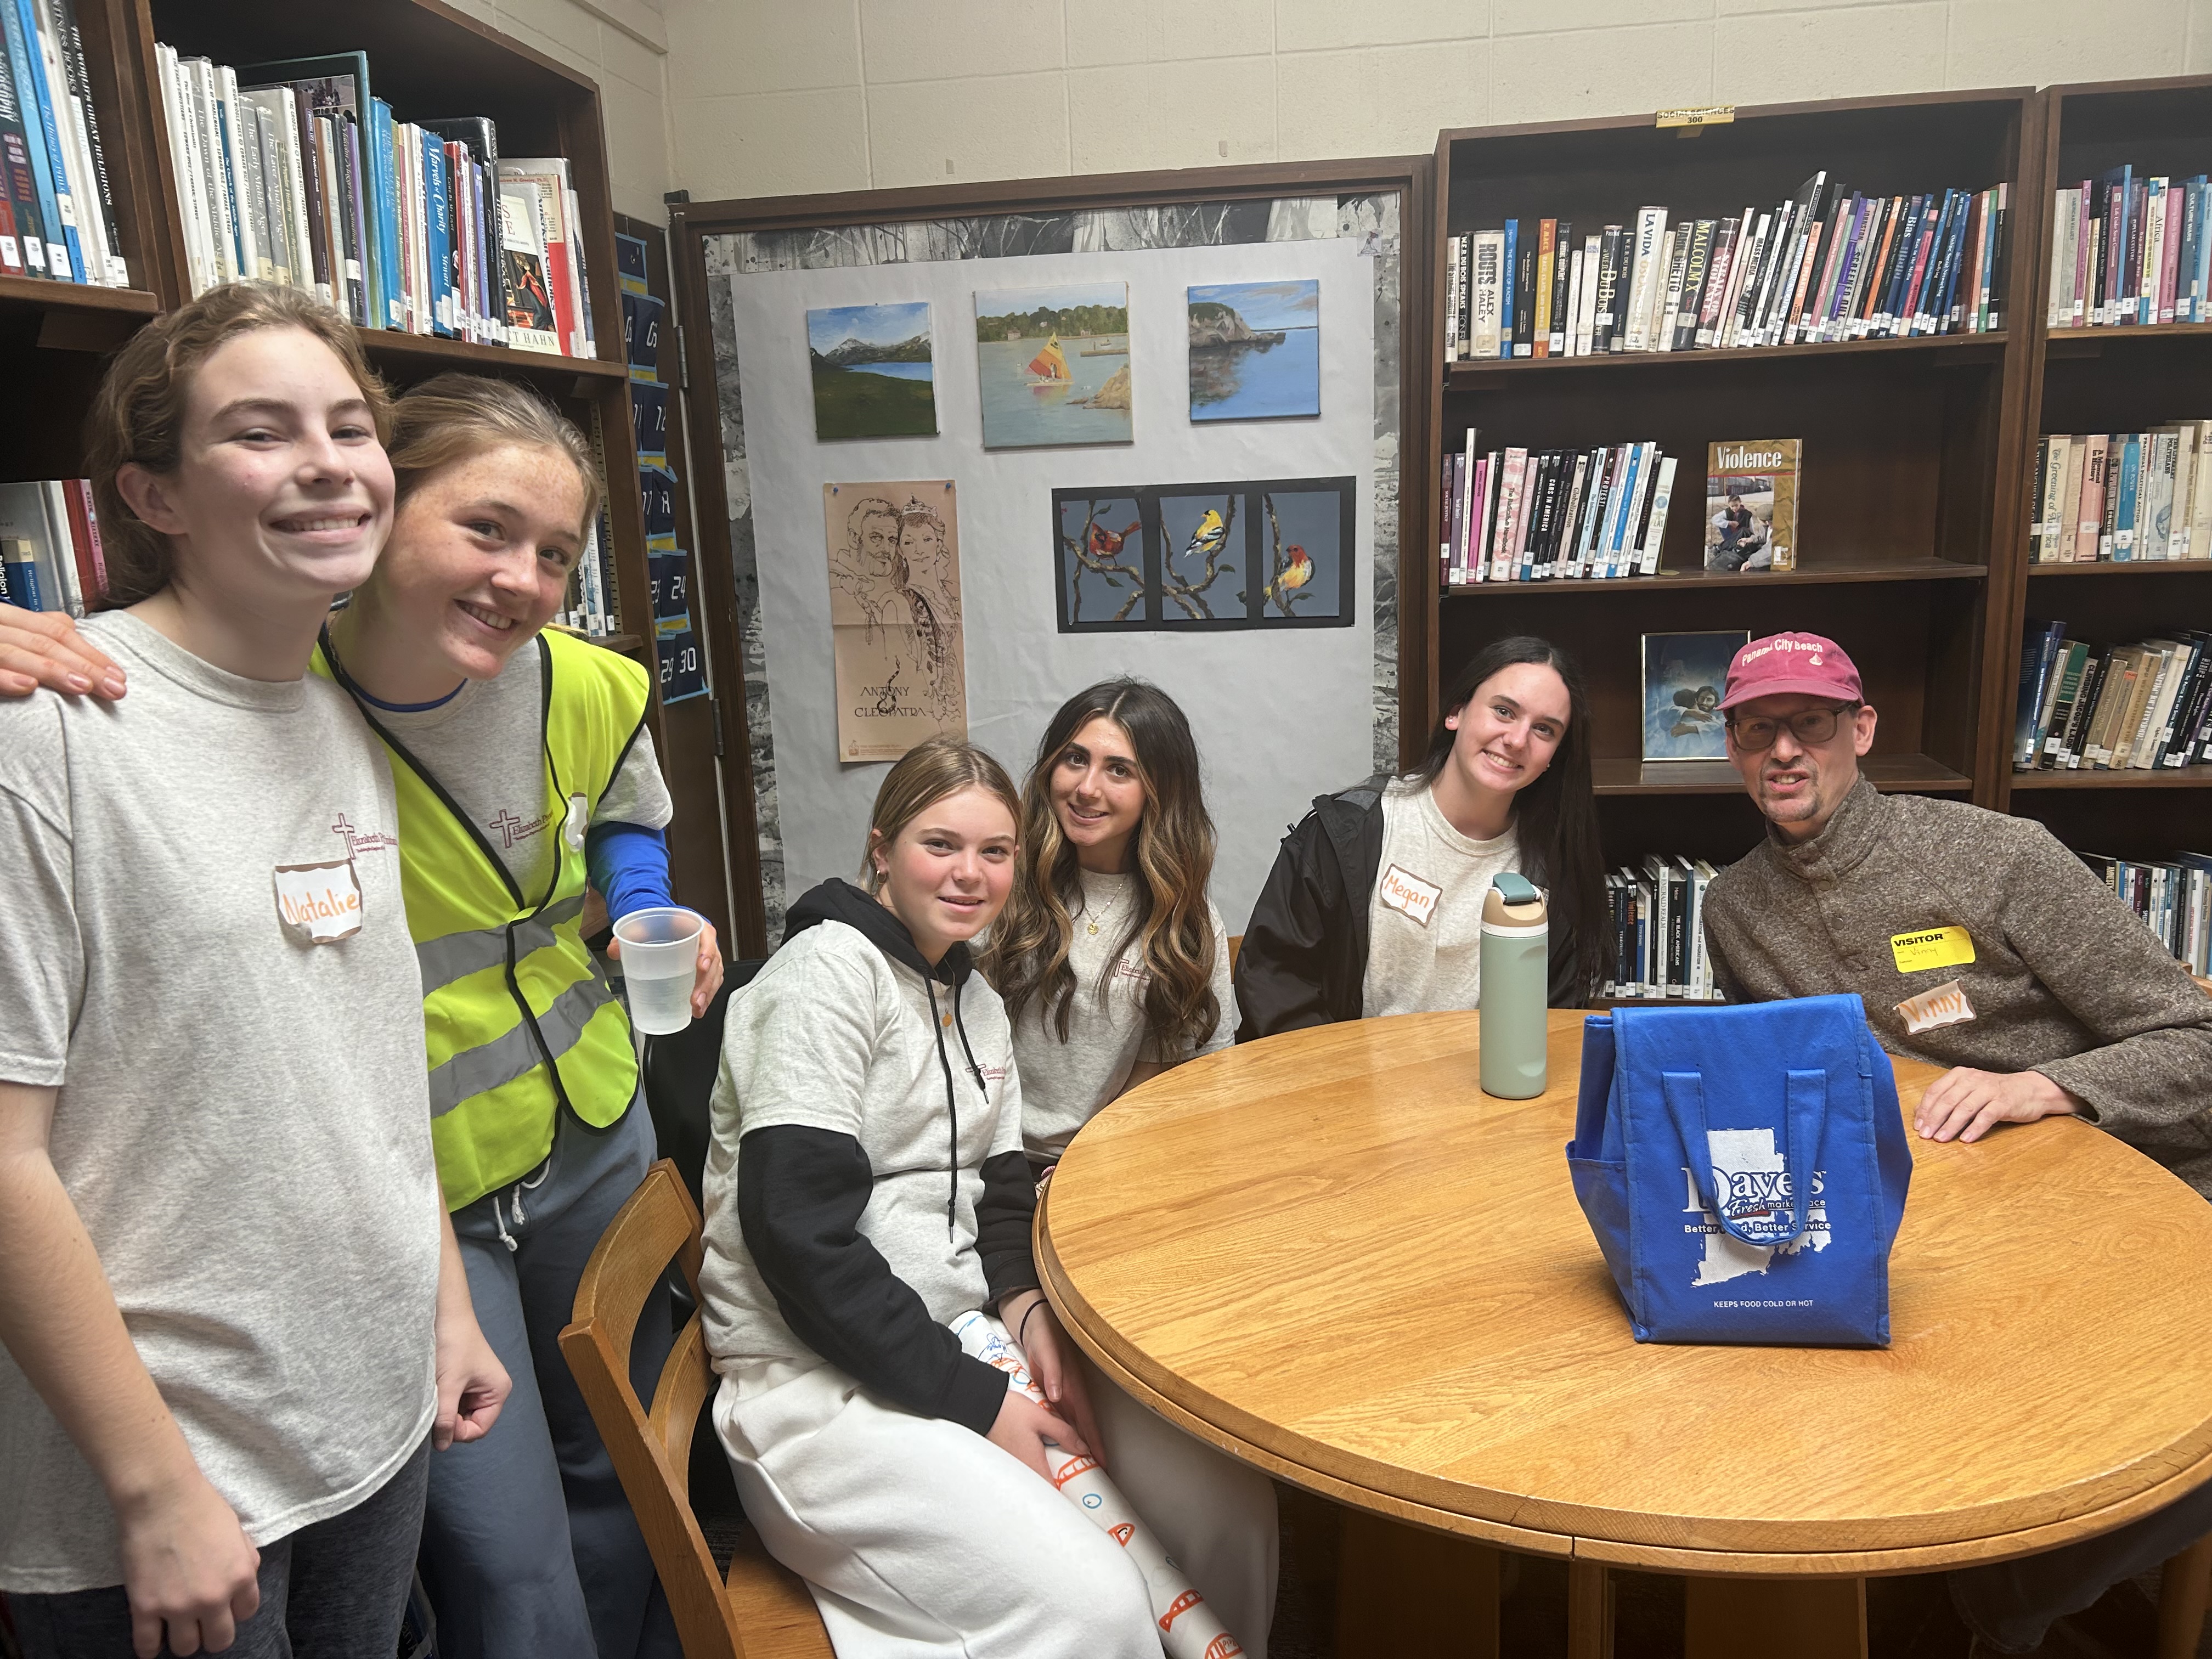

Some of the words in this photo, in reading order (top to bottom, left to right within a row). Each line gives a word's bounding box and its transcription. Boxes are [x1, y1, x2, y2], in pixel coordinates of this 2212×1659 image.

[69, 25, 82, 50] THE
[74, 52, 93, 103] WORLD'S
[84, 103, 100, 143] GREAT
[196, 108, 206, 128] The
[209, 99, 219, 137] CHARLEMAGNE
[246, 121, 256, 140] The
[199, 132, 211, 163] Dawn
[266, 131, 275, 150] The
[247, 145, 260, 170] Early
[268, 153, 279, 178] Later
[427, 142, 443, 186] Marvels
[93, 143, 114, 206] RELIGIONS
[205, 167, 213, 179] of
[206, 182, 216, 200] the
[253, 173, 265, 208] Middle
[272, 182, 284, 216] Middle
[431, 192, 449, 235] Charity
[1644, 212, 1655, 228] LA
[2186, 192, 2196, 223] CULTURE
[209, 203, 221, 239] Middle
[256, 211, 268, 236] Ages
[275, 218, 285, 243] Ages
[1903, 215, 1917, 239] Bias
[2153, 215, 2164, 243] Africa
[2185, 222, 2193, 242] WARS
[213, 242, 223, 258] Ag
[1640, 228, 1653, 257] VIDA
[1675, 223, 1690, 252] DARK
[1753, 236, 1764, 256] MASS
[1947, 234, 1956, 252] Online
[535, 192, 551, 253] American
[543, 256, 557, 311] Catholics
[1460, 256, 1467, 266] DU
[1474, 242, 1498, 286] ROOTS
[1685, 221, 1711, 283] MALCOLM
[1804, 241, 1816, 264] SMART
[1943, 252, 1952, 268] Social
[439, 253, 452, 288] Stewart
[498, 258, 510, 287] BOOK
[1667, 255, 1686, 293] GHETTO
[1747, 255, 1759, 276] MEDIA
[1842, 250, 1861, 297] SCREENED
[1905, 265, 1914, 281] Media
[1684, 283, 1699, 294] X
[1702, 255, 1724, 314] VIOLENCE
[1796, 265, 1810, 298] SPEAKING
[1458, 284, 1466, 309] SPEAKS
[1474, 288, 1491, 323] HALEY
[1483, 289, 1498, 316] ALEX
[1836, 298, 1849, 319] OUT
[523, 331, 556, 347] HAHN
[1457, 314, 1466, 340] FONER
[1717, 445, 1782, 469] Violence
[2052, 447, 2061, 461] The
[2140, 436, 2148, 468] PRACTICAL
[2046, 461, 2061, 500] Greening
[2087, 456, 2097, 482] History
[2094, 455, 2103, 484] Moment
[1546, 478, 1556, 495] CARS
[2136, 469, 2145, 500] POLITICAL
[1544, 495, 1553, 504] IN
[1563, 486, 1582, 529] Globalization
[2047, 501, 2057, 511] of
[1539, 504, 1551, 532] AMERICA
[1500, 526, 1510, 554] Handbook
[671, 576, 687, 600] 24
[679, 647, 697, 674] 30
[1742, 643, 1773, 667] Panama
[1774, 639, 1793, 653] City
[1795, 640, 1823, 653] Beach
[860, 687, 910, 696] ANTONY
[2078, 663, 2098, 699] CLIMBING
[855, 707, 927, 718] CLEOPATRA
[2069, 698, 2087, 729] JACOB'S
[2063, 727, 2078, 751] LADD
[2104, 865, 2116, 889] AMNESTY
[1384, 875, 1430, 909] Megan
[1659, 878, 1667, 907] EMERALD
[283, 888, 360, 926] Natalie
[1624, 899, 1637, 925] Violence
[1894, 933, 1944, 947] VISITOR
[1910, 947, 1939, 956] Vinny
[1729, 1199, 1765, 1217] Fresh
[1684, 1224, 1717, 1233] Better
[1754, 1223, 1788, 1232] Better
[1792, 1222, 1831, 1232] Srvice
